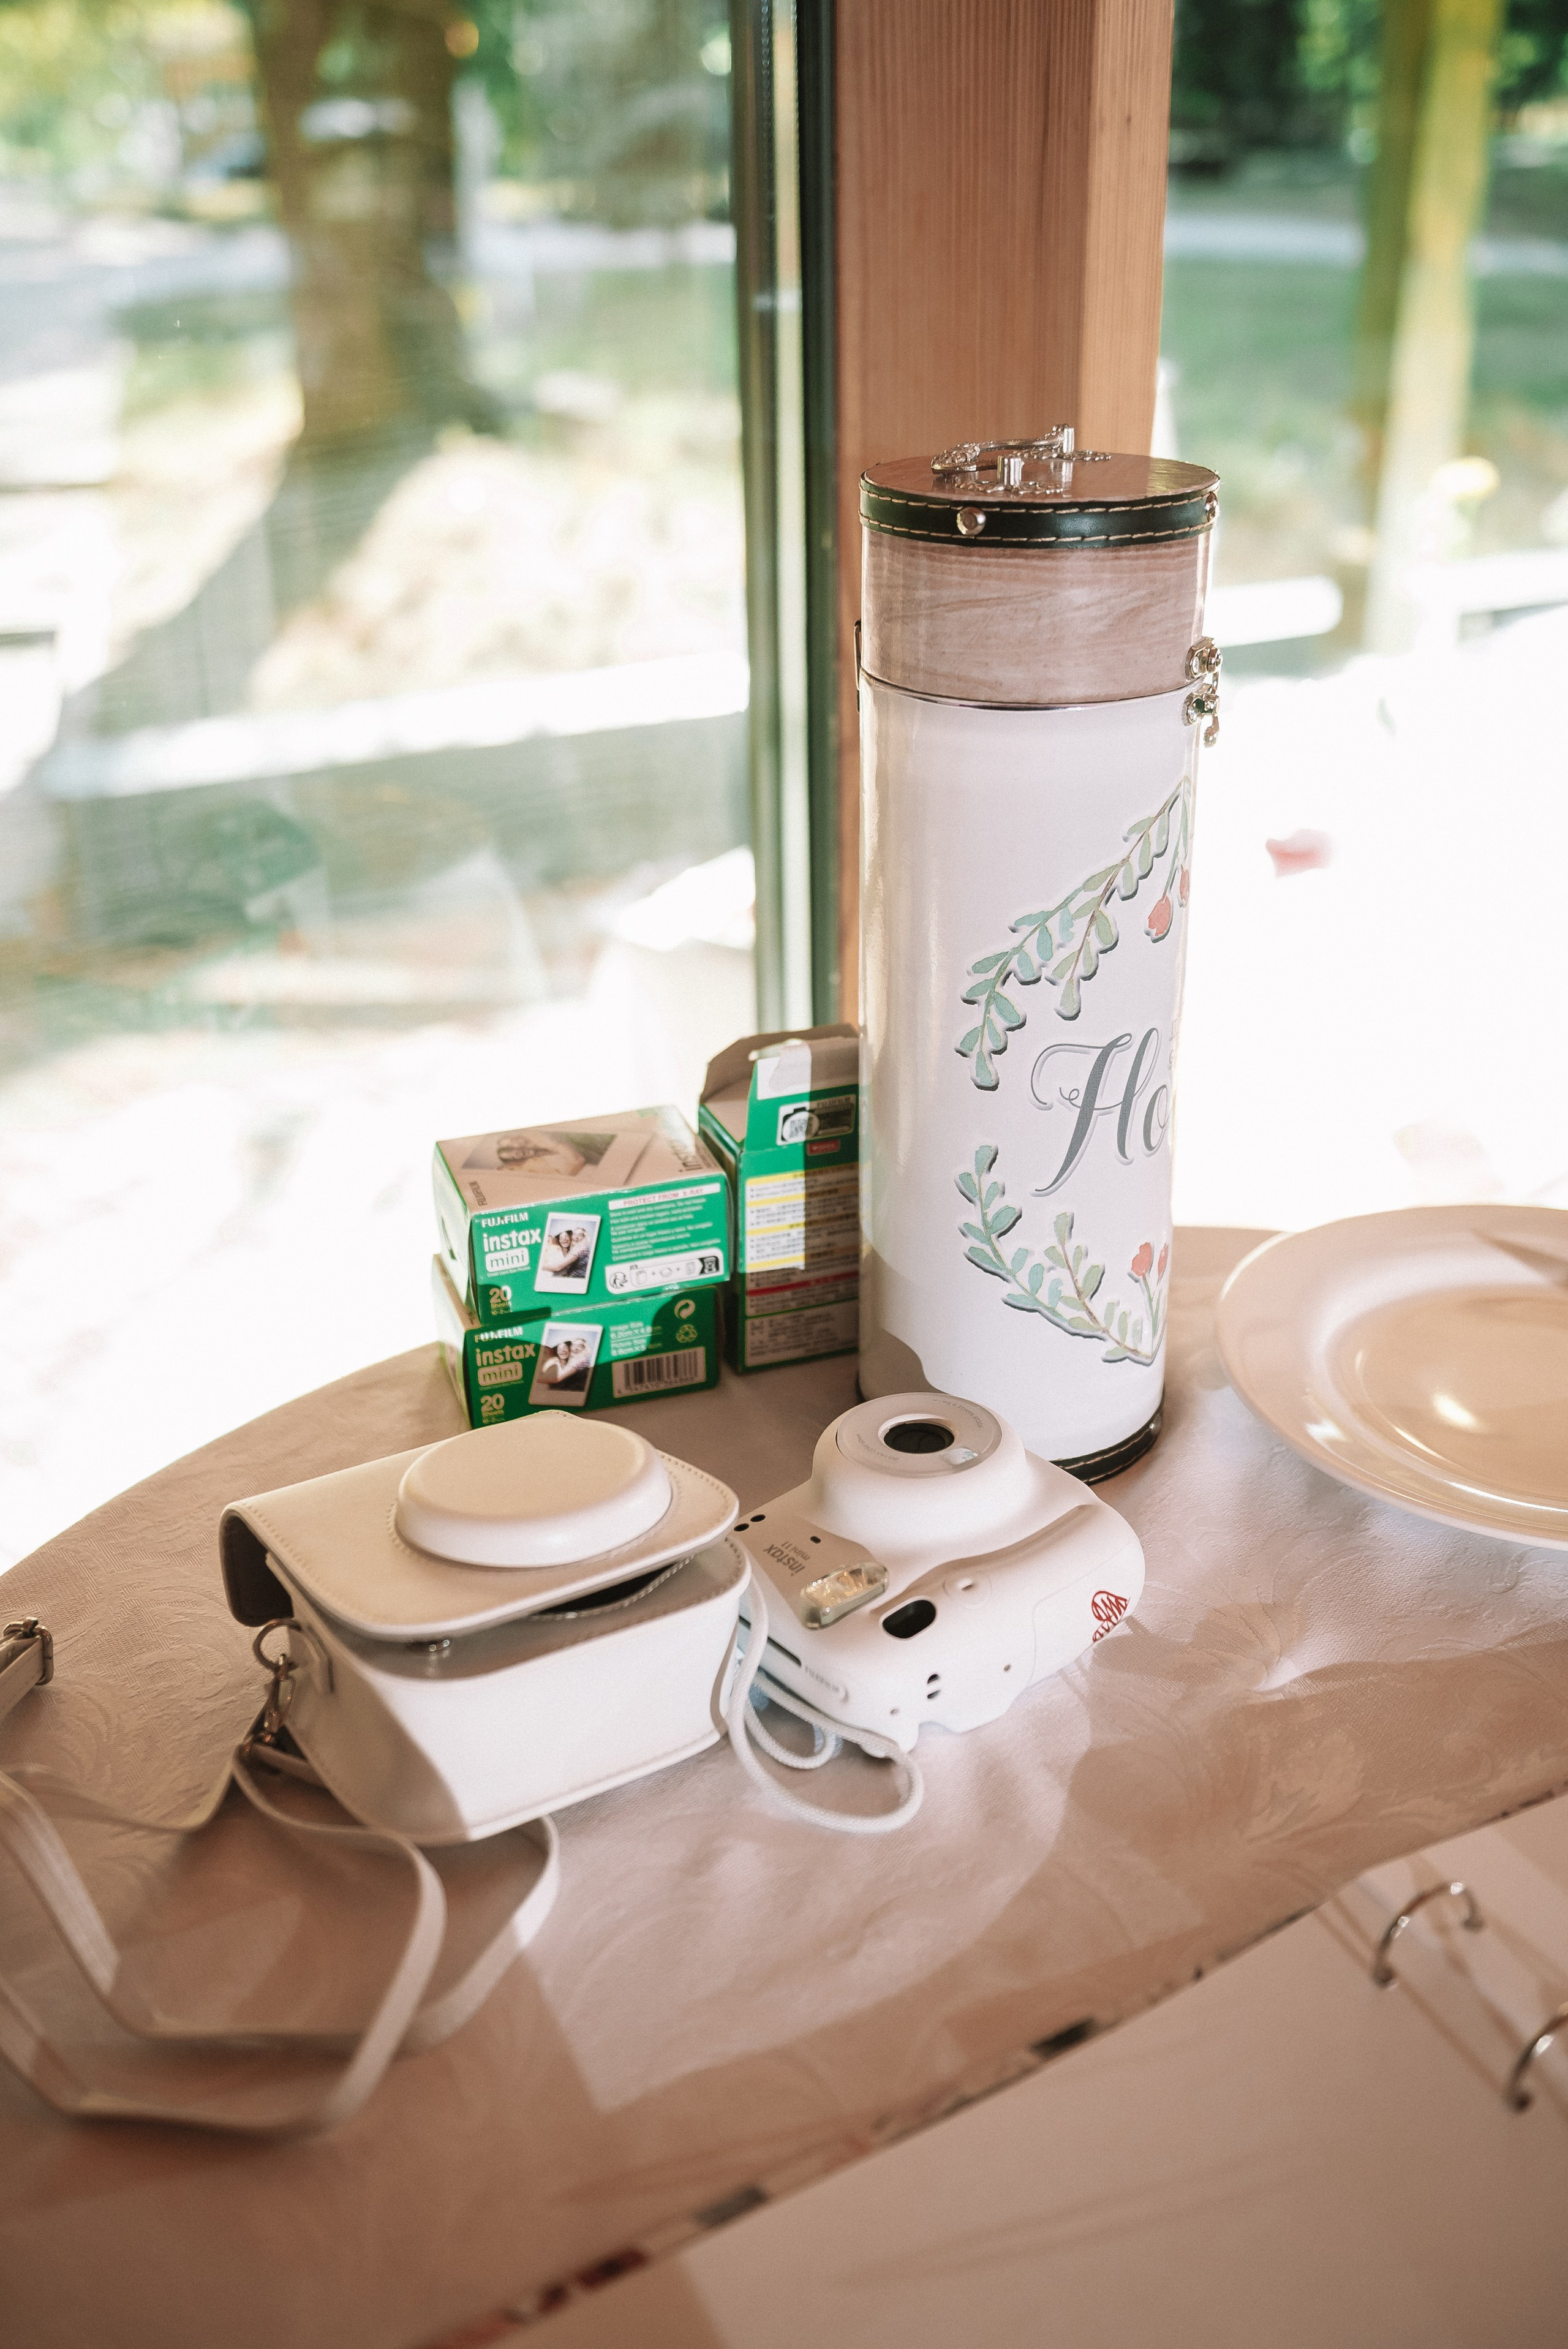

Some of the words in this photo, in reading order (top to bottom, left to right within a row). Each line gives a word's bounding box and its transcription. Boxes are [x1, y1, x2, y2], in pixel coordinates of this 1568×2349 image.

[624, 1196, 656, 1207] PROTECT
[481, 1212, 529, 1228] FUJIFILM
[483, 1229, 541, 1252] instax
[490, 1251, 525, 1268] mini
[489, 1285, 511, 1304] 20
[475, 1343, 536, 1367] instax
[482, 1365, 518, 1382] mini
[480, 1393, 505, 1412] 20
[763, 1544, 805, 1577] instax
